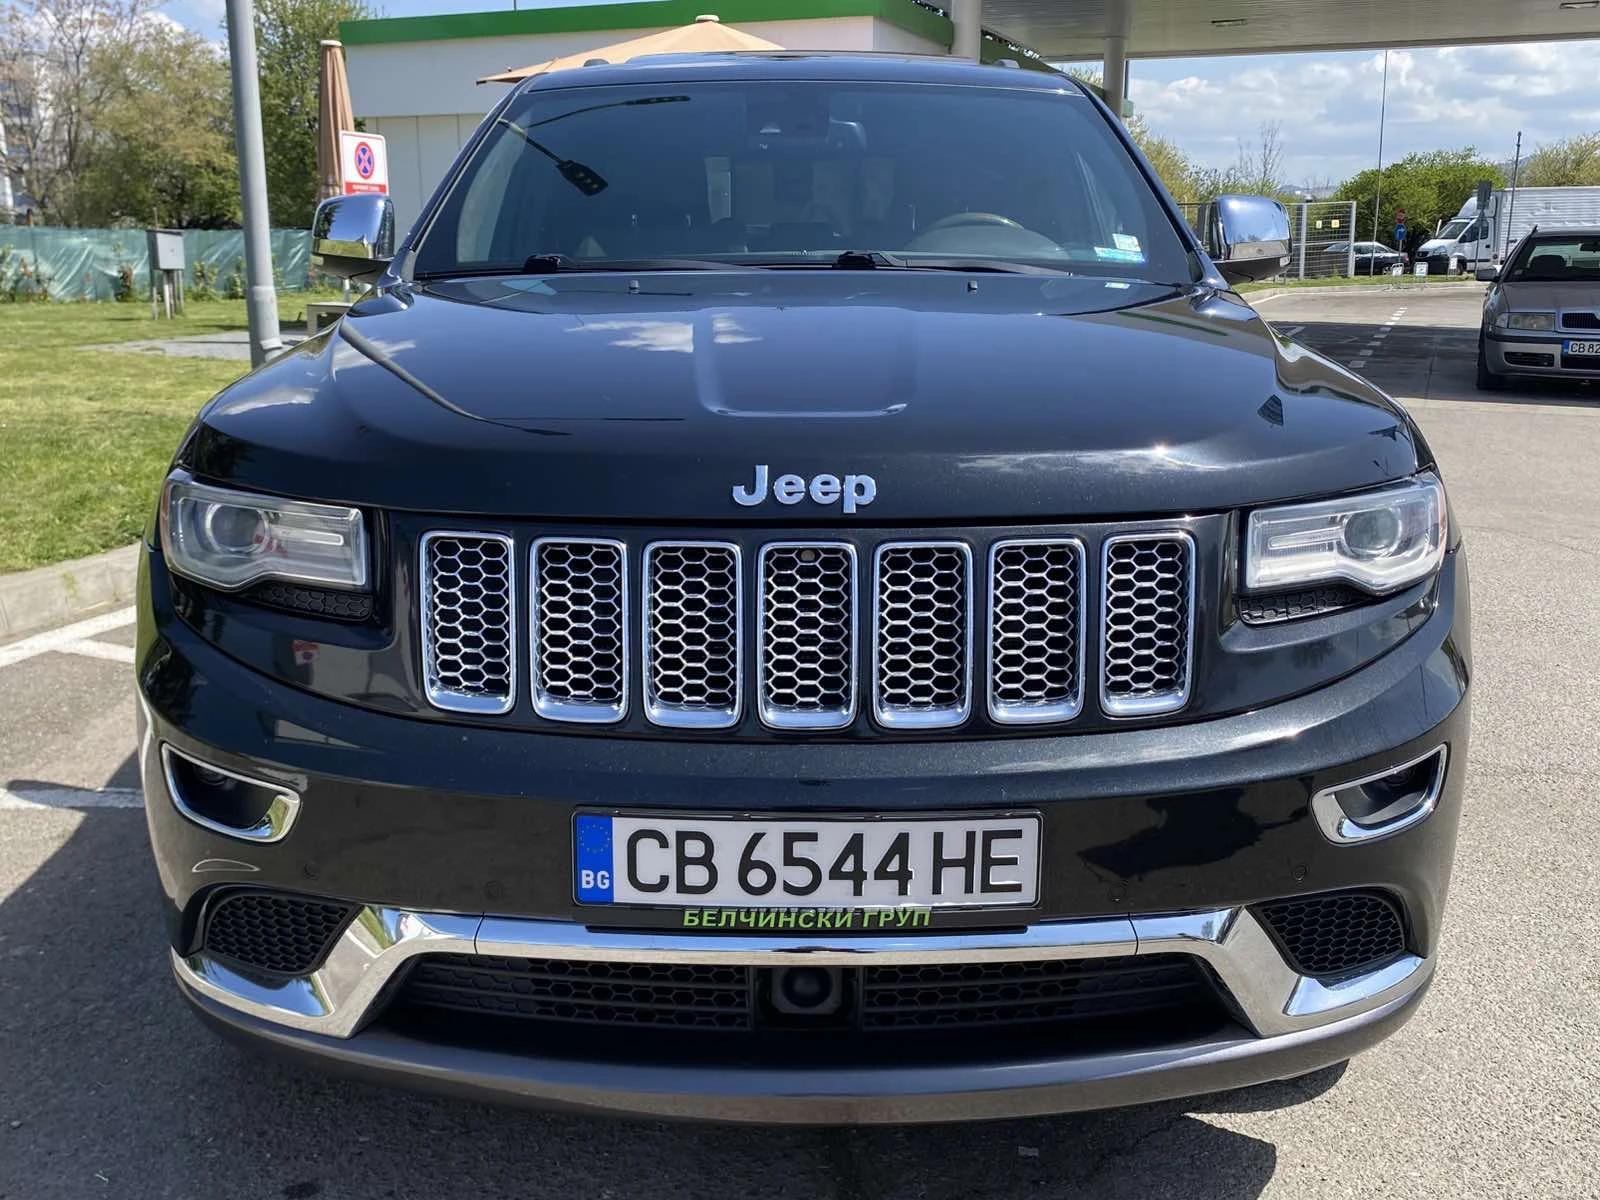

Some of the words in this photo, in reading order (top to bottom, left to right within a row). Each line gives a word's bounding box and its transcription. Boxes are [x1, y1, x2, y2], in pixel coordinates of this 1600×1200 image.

[732, 464, 877, 514] Jeep
[581, 869, 610, 889] BG
[627, 829, 718, 894] CB
[738, 832, 914, 896] 6544
[932, 829, 1023, 895] HE
[683, 908, 852, 928] БЕЛЧИНСКИ
[862, 907, 932, 928] ГРУП
